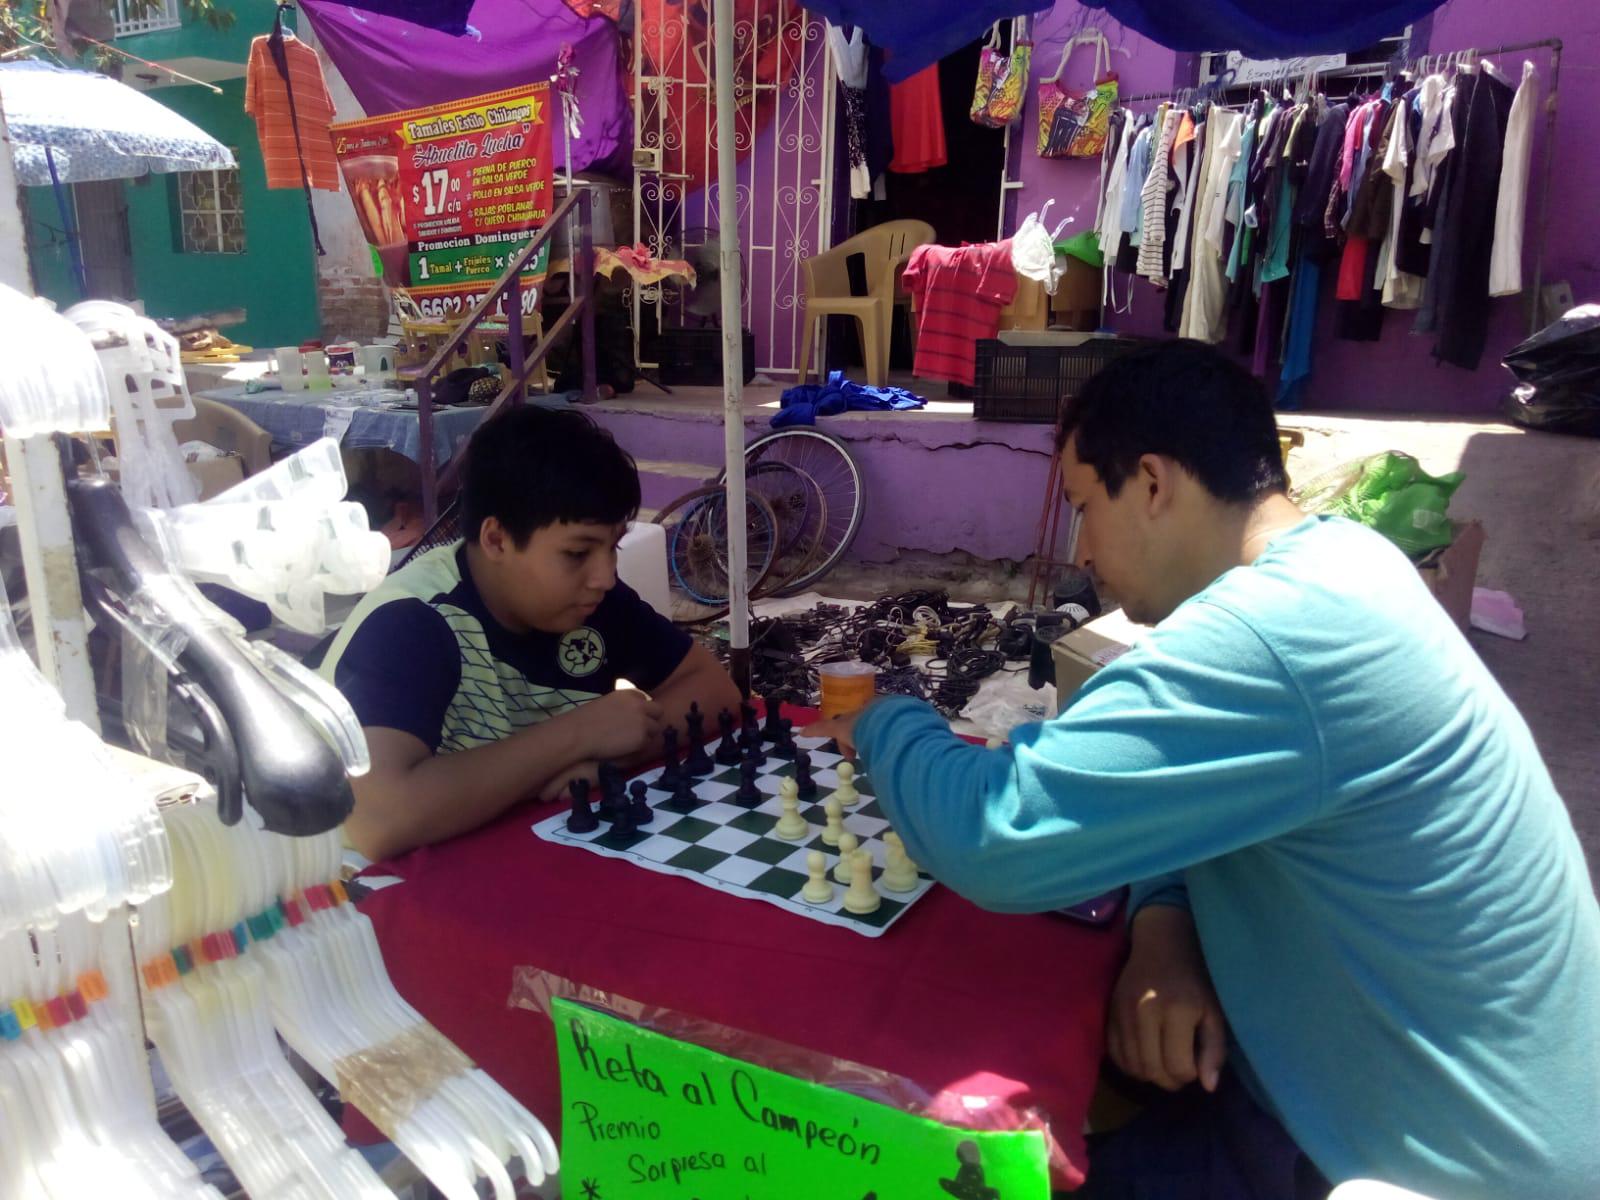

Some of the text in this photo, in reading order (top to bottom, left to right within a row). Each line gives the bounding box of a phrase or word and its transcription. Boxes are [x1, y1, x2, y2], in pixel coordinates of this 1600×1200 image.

[408, 120, 456, 139] Tamales
[456, 112, 485, 131] Estilo
[497, 162, 507, 172] DE
[509, 158, 537, 170] PUERCO
[505, 169, 528, 182] VERDE
[412, 184, 420, 204] $
[421, 168, 449, 216] 17
[525, 180, 545, 193] VERDE
[417, 235, 471, 252] Promocion
[418, 256, 430, 280] 1
[430, 261, 453, 274] Tamal
[570, 1017, 881, 1166] Reta al Campeón
[571, 1099, 662, 1143] Premio
[627, 1152, 767, 1185] Sorpresa al
